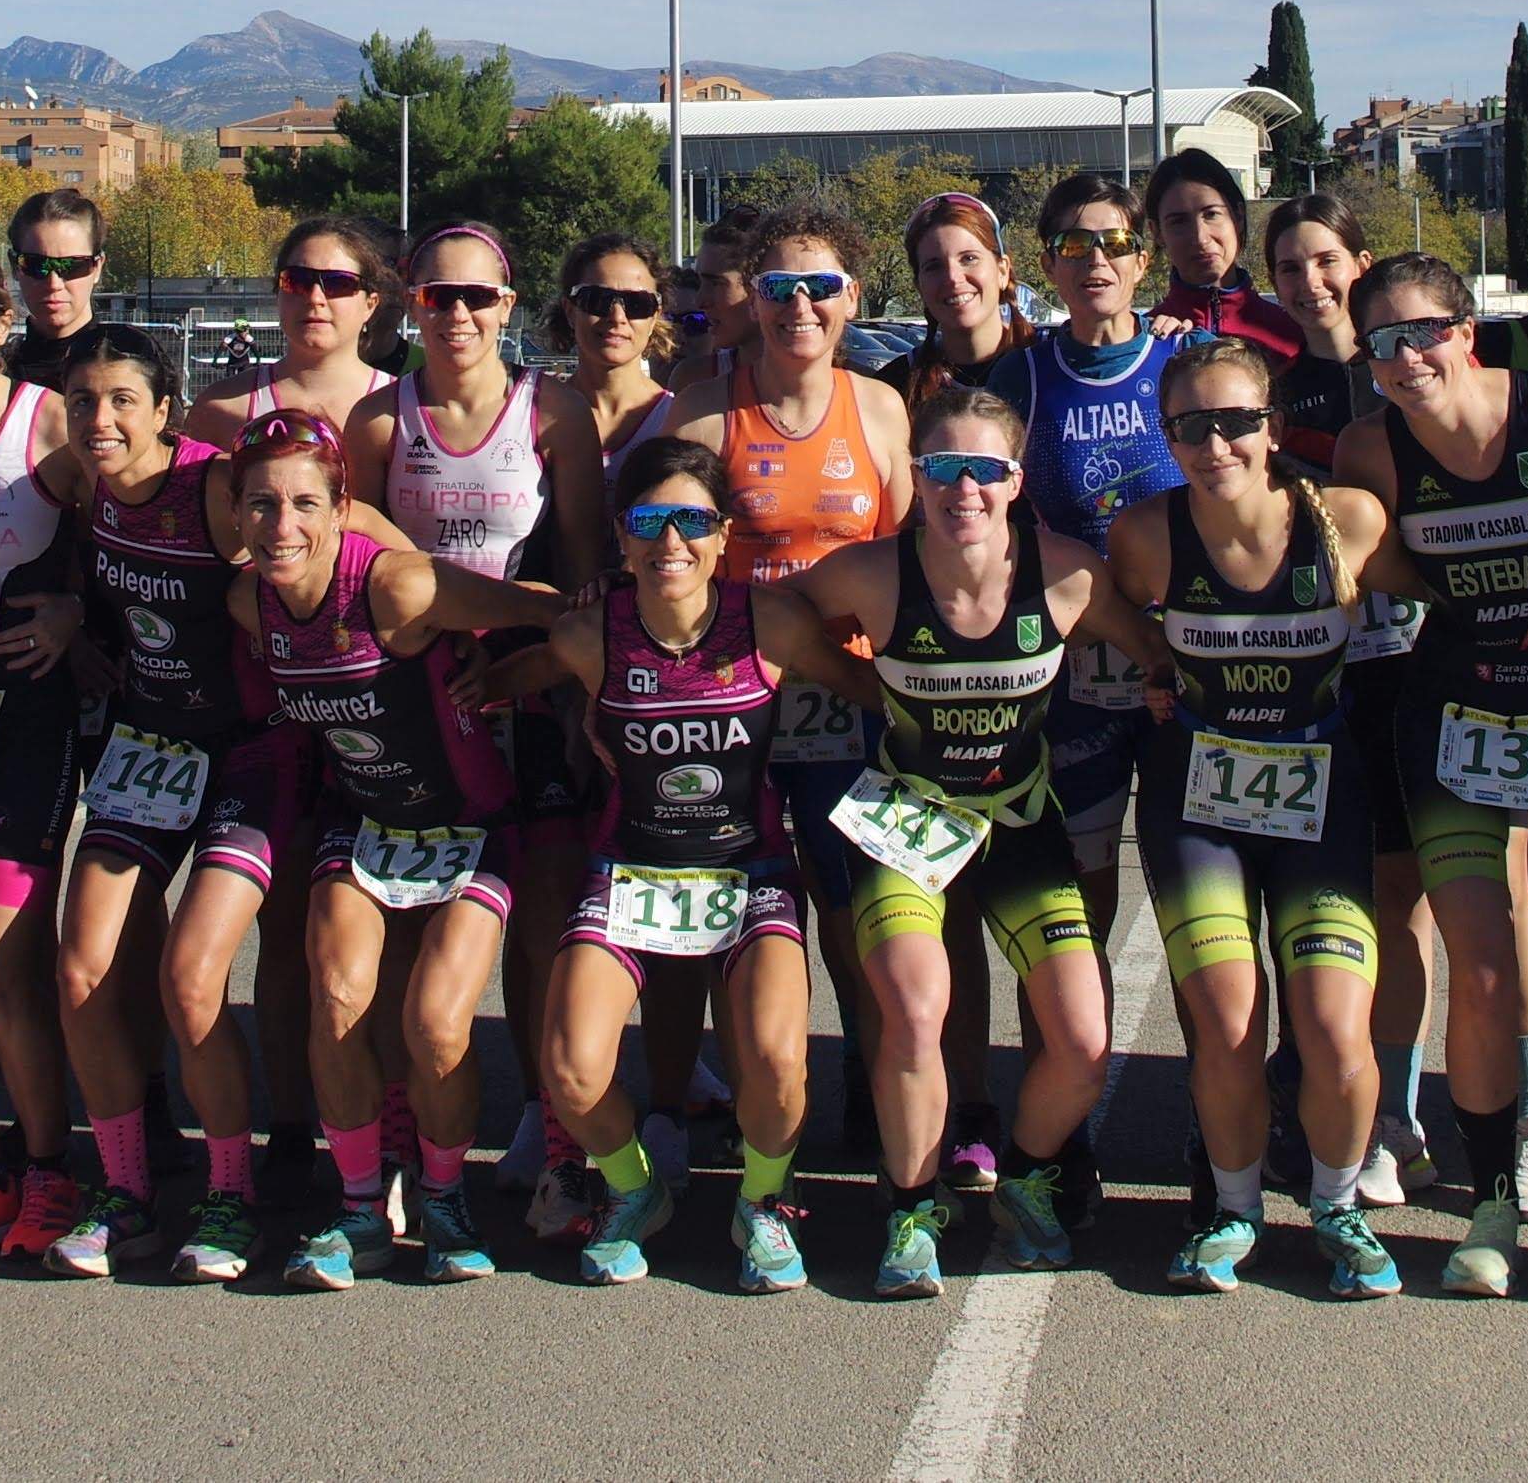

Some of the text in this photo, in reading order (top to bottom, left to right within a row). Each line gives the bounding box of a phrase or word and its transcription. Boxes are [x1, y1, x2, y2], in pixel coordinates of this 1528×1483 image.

[1063, 400, 1148, 442] ALTABA
[399, 489, 530, 514] EUROPA
[435, 482, 485, 491] TRIATLON
[437, 519, 487, 548] ZARO
[1422, 522, 1475, 544] STADIUM
[96, 551, 186, 602] Pelegrín
[1183, 626, 1330, 648] STADIUM CASABLANCA
[905, 667, 1047, 693] STADIUM CASABLANCA
[1223, 664, 1291, 694] MORO
[278, 687, 385, 722] Gutierrez
[932, 702, 1020, 736] BORBÓN
[1226, 707, 1286, 722] MAPEI
[624, 717, 751, 756] SORIA
[943, 744, 1004, 760] MAPEI
[107, 750, 200, 807] 144
[1209, 756, 1317, 813] 142
[861, 785, 972, 863] 147
[372, 843, 470, 885] 123
[632, 888, 738, 932] 118
